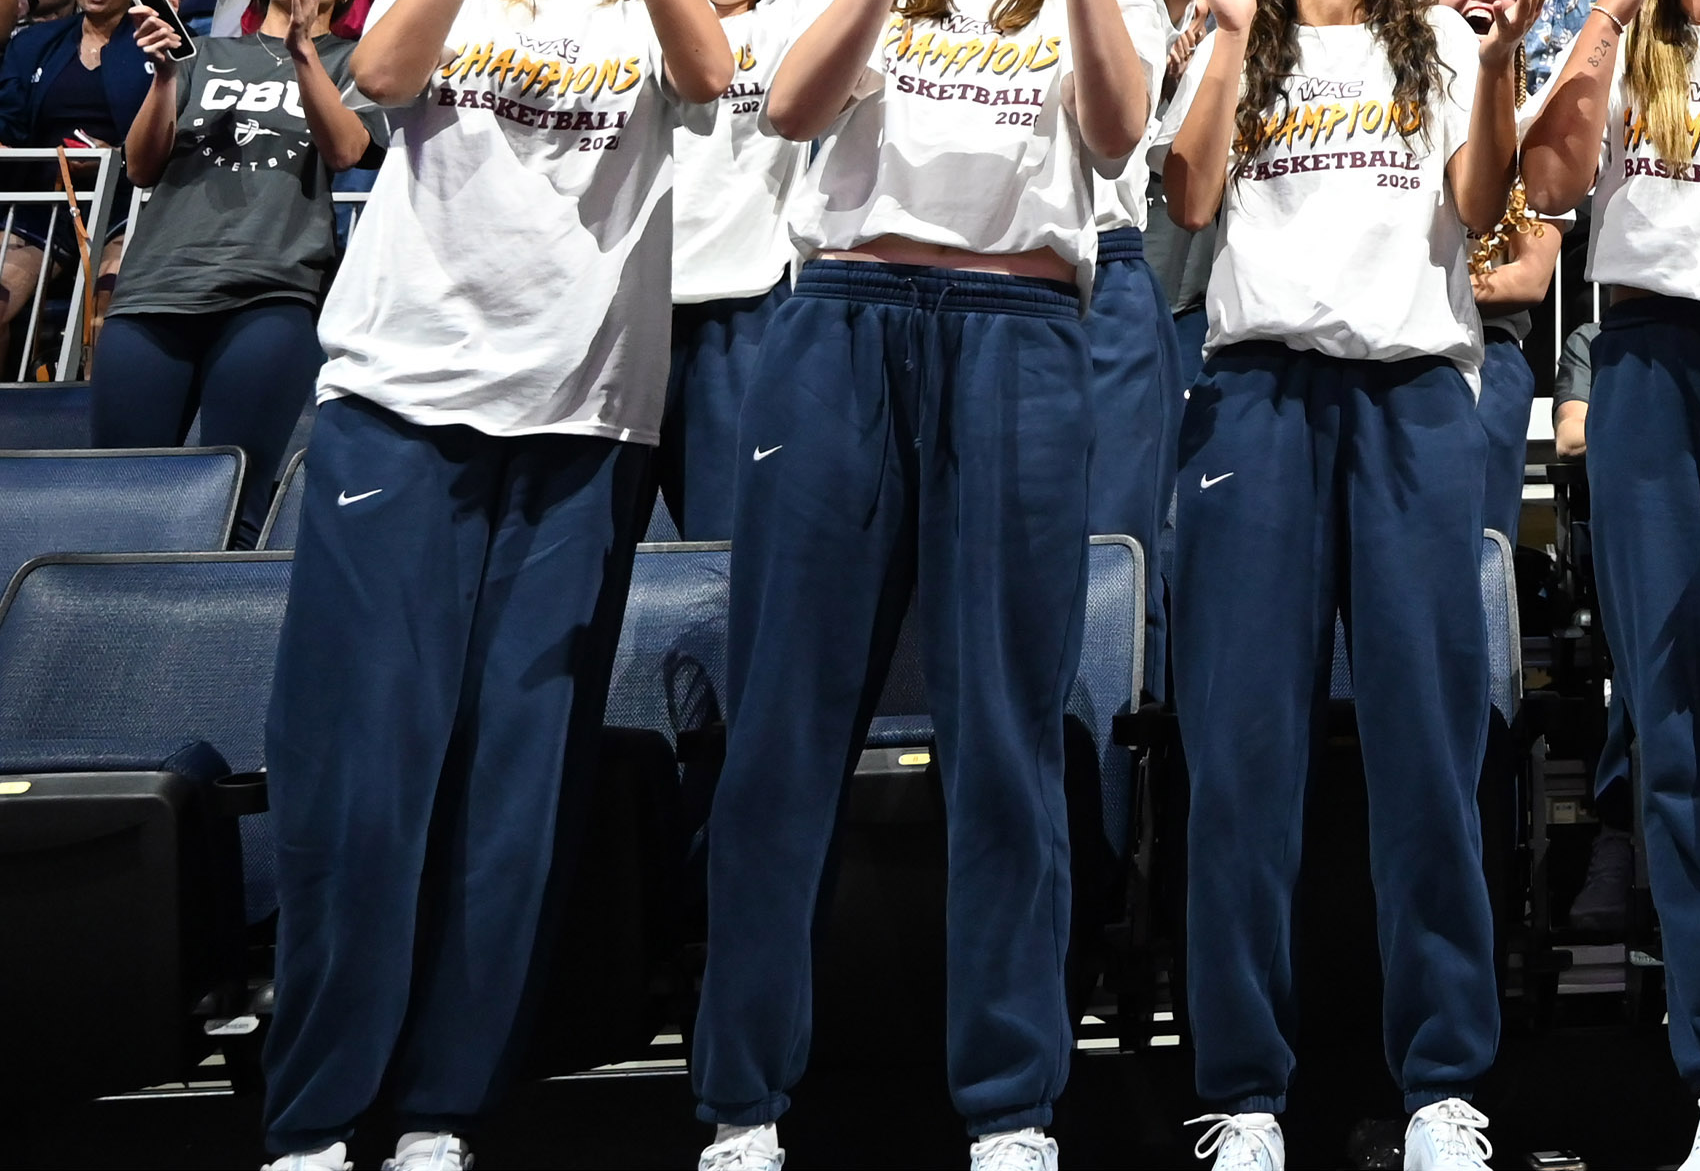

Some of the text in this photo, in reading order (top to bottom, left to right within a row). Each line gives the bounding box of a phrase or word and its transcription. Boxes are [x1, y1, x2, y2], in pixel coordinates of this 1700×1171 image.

[1587, 39, 1611, 67] 8:24
[1300, 78, 1364, 101] WAC
[731, 101, 760, 115] 202
[193, 118, 312, 172] BASKETBAL
[578, 135, 621, 153] 202
[1376, 173, 1421, 190] 2026
